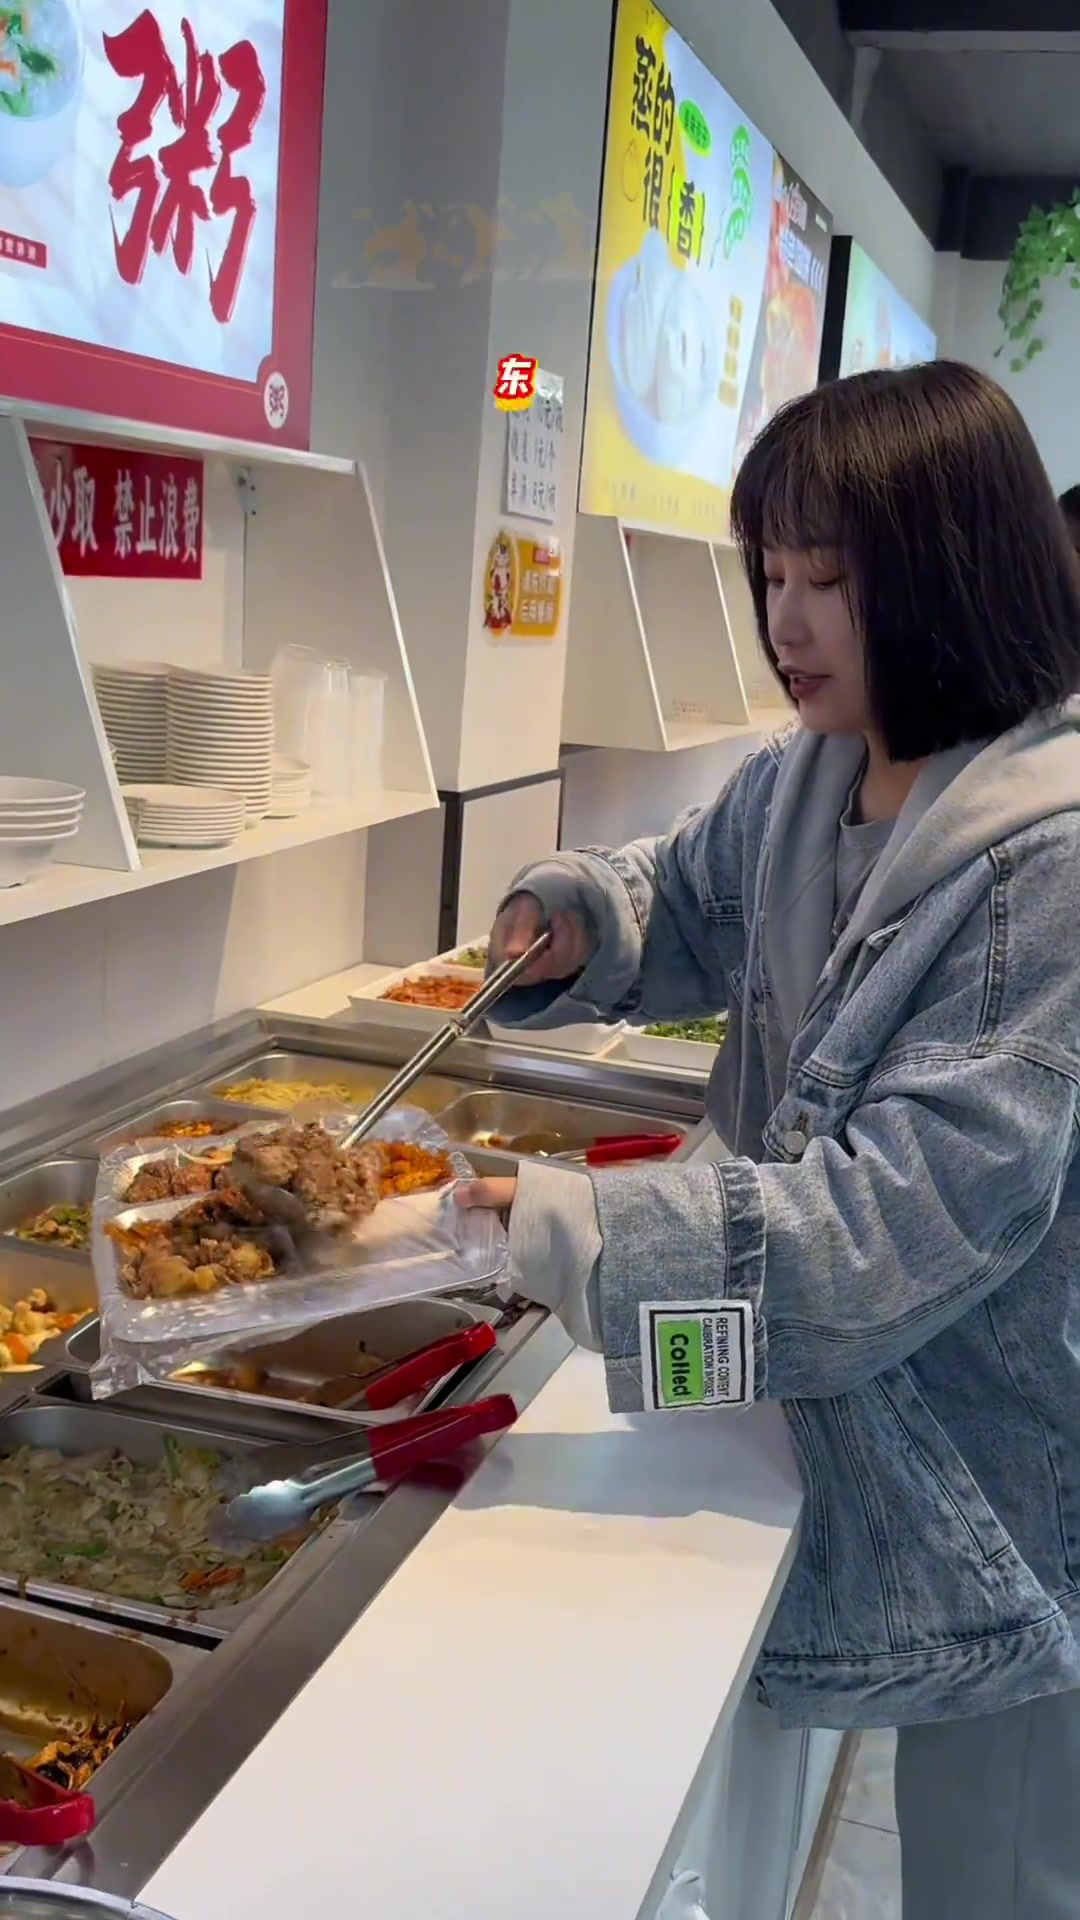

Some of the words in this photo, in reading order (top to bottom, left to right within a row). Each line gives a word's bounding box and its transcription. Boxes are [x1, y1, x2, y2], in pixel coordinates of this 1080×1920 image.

[632, 34, 675, 156] 蒸的
[102, 8, 266, 324] 粥
[643, 146, 697, 258] 很香
[113, 469, 199, 563] 禁止浪费
[716, 1317, 729, 1364] REFINING
